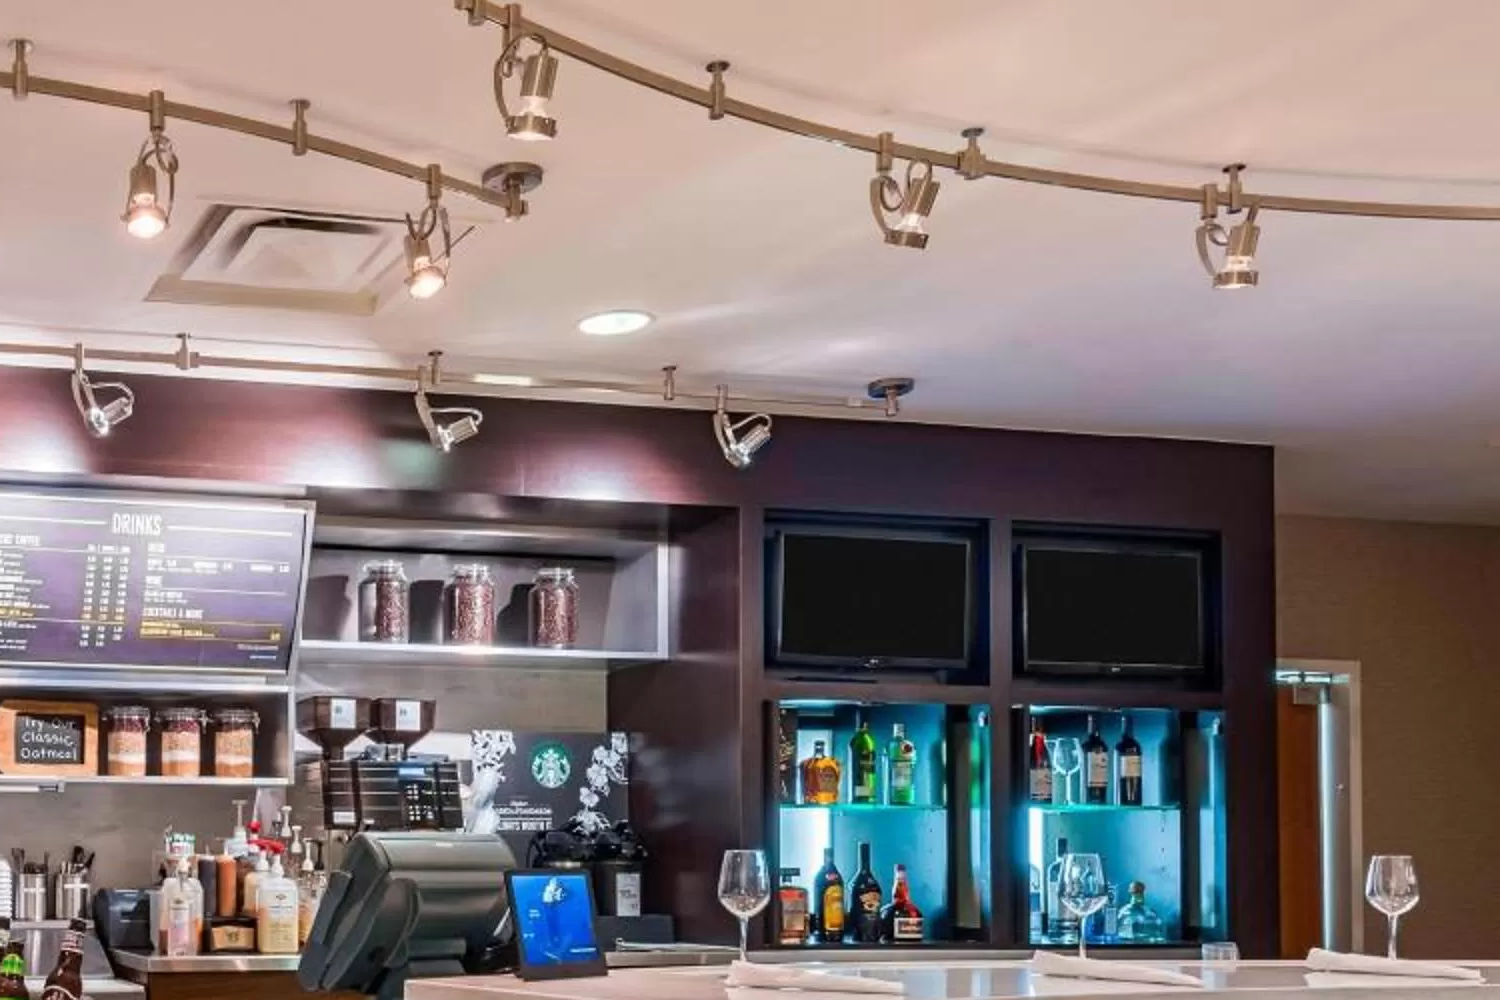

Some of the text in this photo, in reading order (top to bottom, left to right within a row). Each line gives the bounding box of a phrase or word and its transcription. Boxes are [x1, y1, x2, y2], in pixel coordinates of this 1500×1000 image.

[112, 512, 162, 536] DRINKS
[23, 716, 75, 733] Try Our
[22, 731, 75, 747] Classic
[21, 747, 77, 761] Oatmeal
